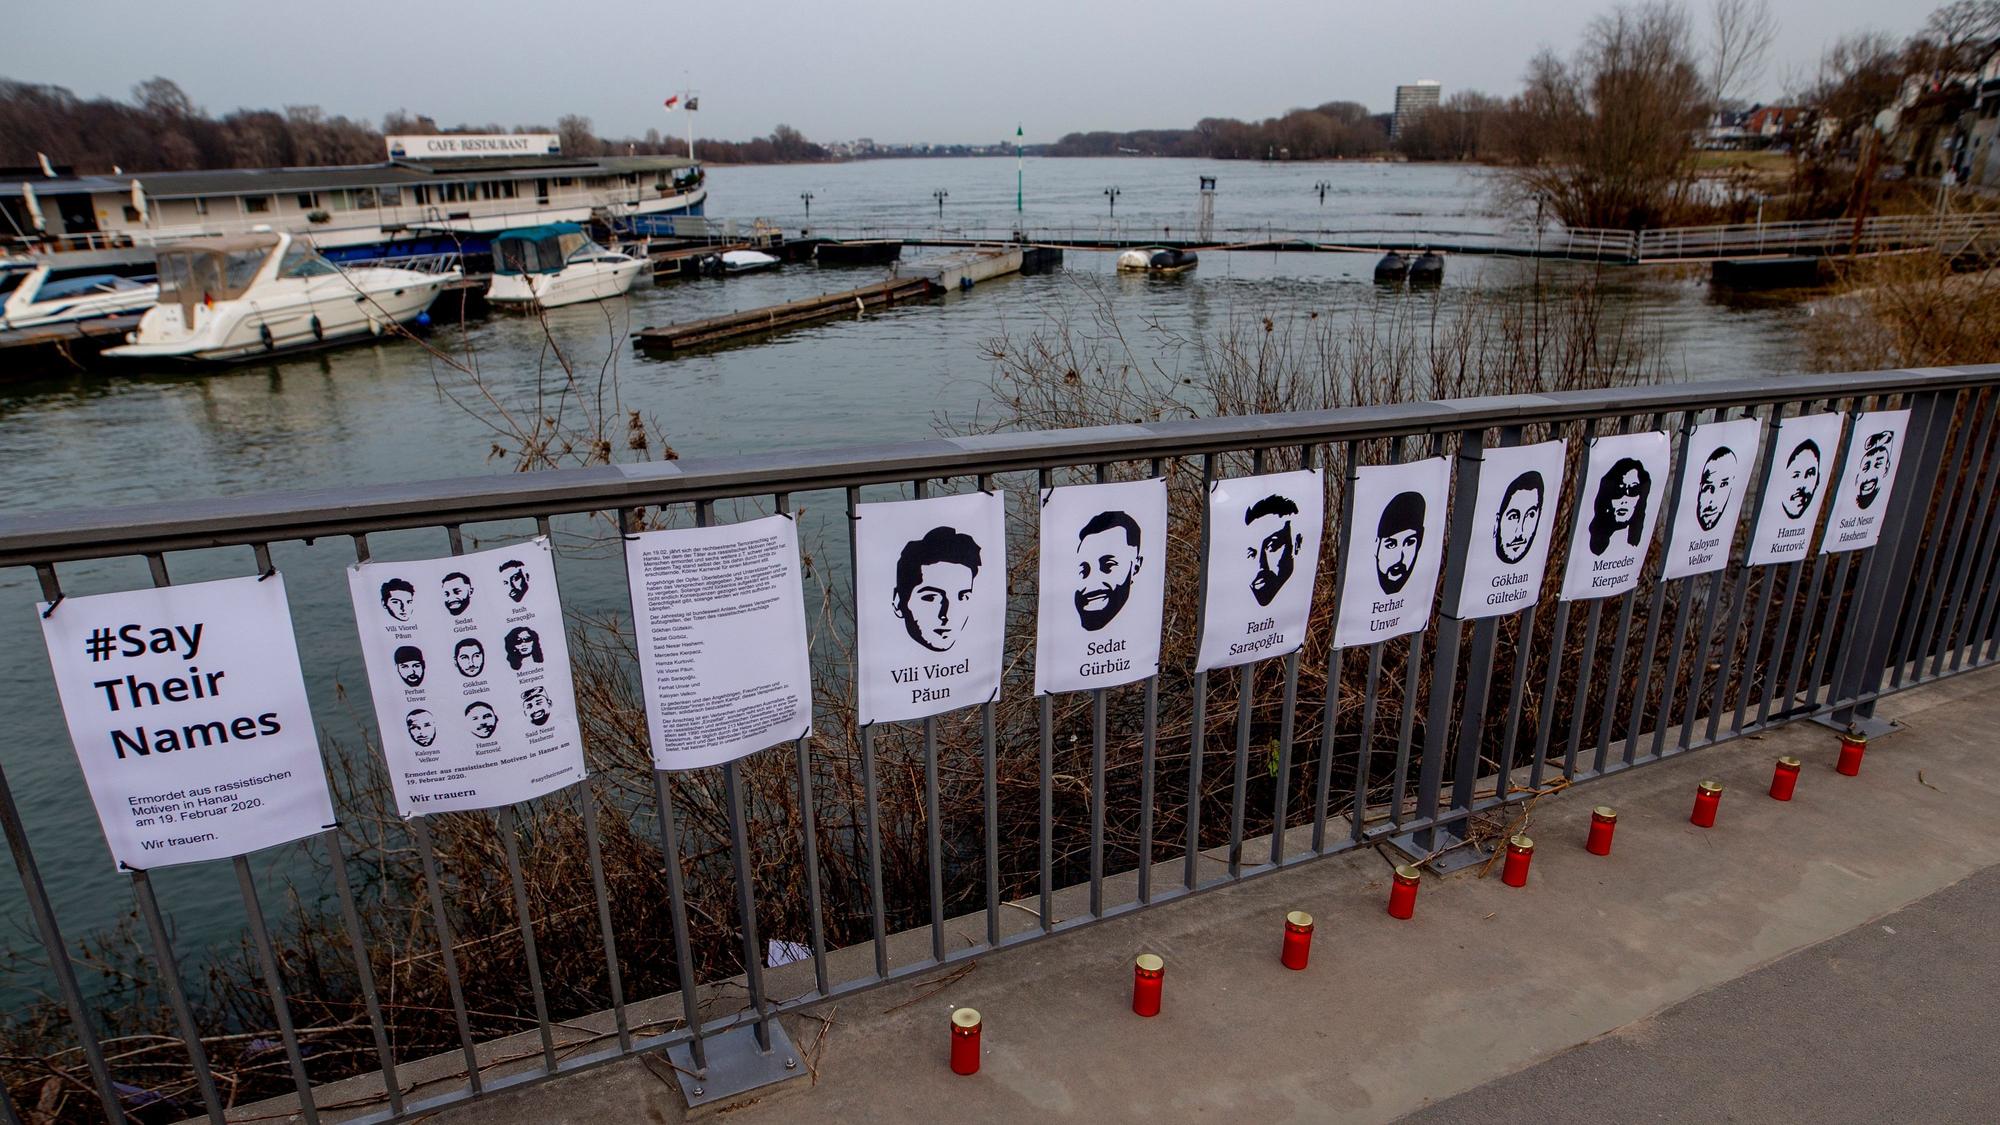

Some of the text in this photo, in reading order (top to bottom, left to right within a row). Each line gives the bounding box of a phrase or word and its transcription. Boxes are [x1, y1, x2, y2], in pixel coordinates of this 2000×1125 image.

[1840, 517, 1874, 528] Said Nesar
[1778, 528, 1805, 538] Hamza
[1840, 530, 1868, 542] Hashemi
[1689, 539, 1719, 552] Kaloyan
[1771, 540, 1805, 553] Kurtović
[1593, 556, 1634, 571] Mercedes
[1689, 554, 1713, 566] Velkov
[1492, 573, 1528, 587] Gökhan
[1592, 574, 1629, 588] Kierpacz
[1487, 589, 1527, 605] Gültekin
[1372, 599, 1404, 614] Ferhat
[454, 624, 477, 633] Gürbüz
[1247, 618, 1274, 634] Fatih
[1371, 618, 1400, 632] Unvar
[86, 623, 203, 662] #Say
[1088, 639, 1126, 656] Sedat
[1230, 633, 1284, 656] Saraçoğlu
[516, 668, 544, 678] Mercedes
[891, 659, 968, 683] Vili Viorel
[1080, 659, 1130, 676] Gürbüz
[94, 667, 224, 711] Their
[463, 688, 490, 696] Gültekin
[912, 688, 950, 703] Păun
[111, 713, 280, 759] Names
[419, 755, 439, 763] Velkov
[455, 762, 498, 772] rassistischen
[501, 756, 528, 765] Motiven
[539, 746, 558, 755] Hanau
[419, 776, 445, 784] Februar
[128, 772, 291, 806] Ermordet aus rassistischen
[434, 790, 476, 800] trauern
[132, 794, 238, 816] Motiven in Hanau
[159, 811, 177, 823] 19.
[181, 807, 228, 821] Februar
[232, 799, 264, 812] 2020.
[142, 834, 218, 850] Wir trauern.
